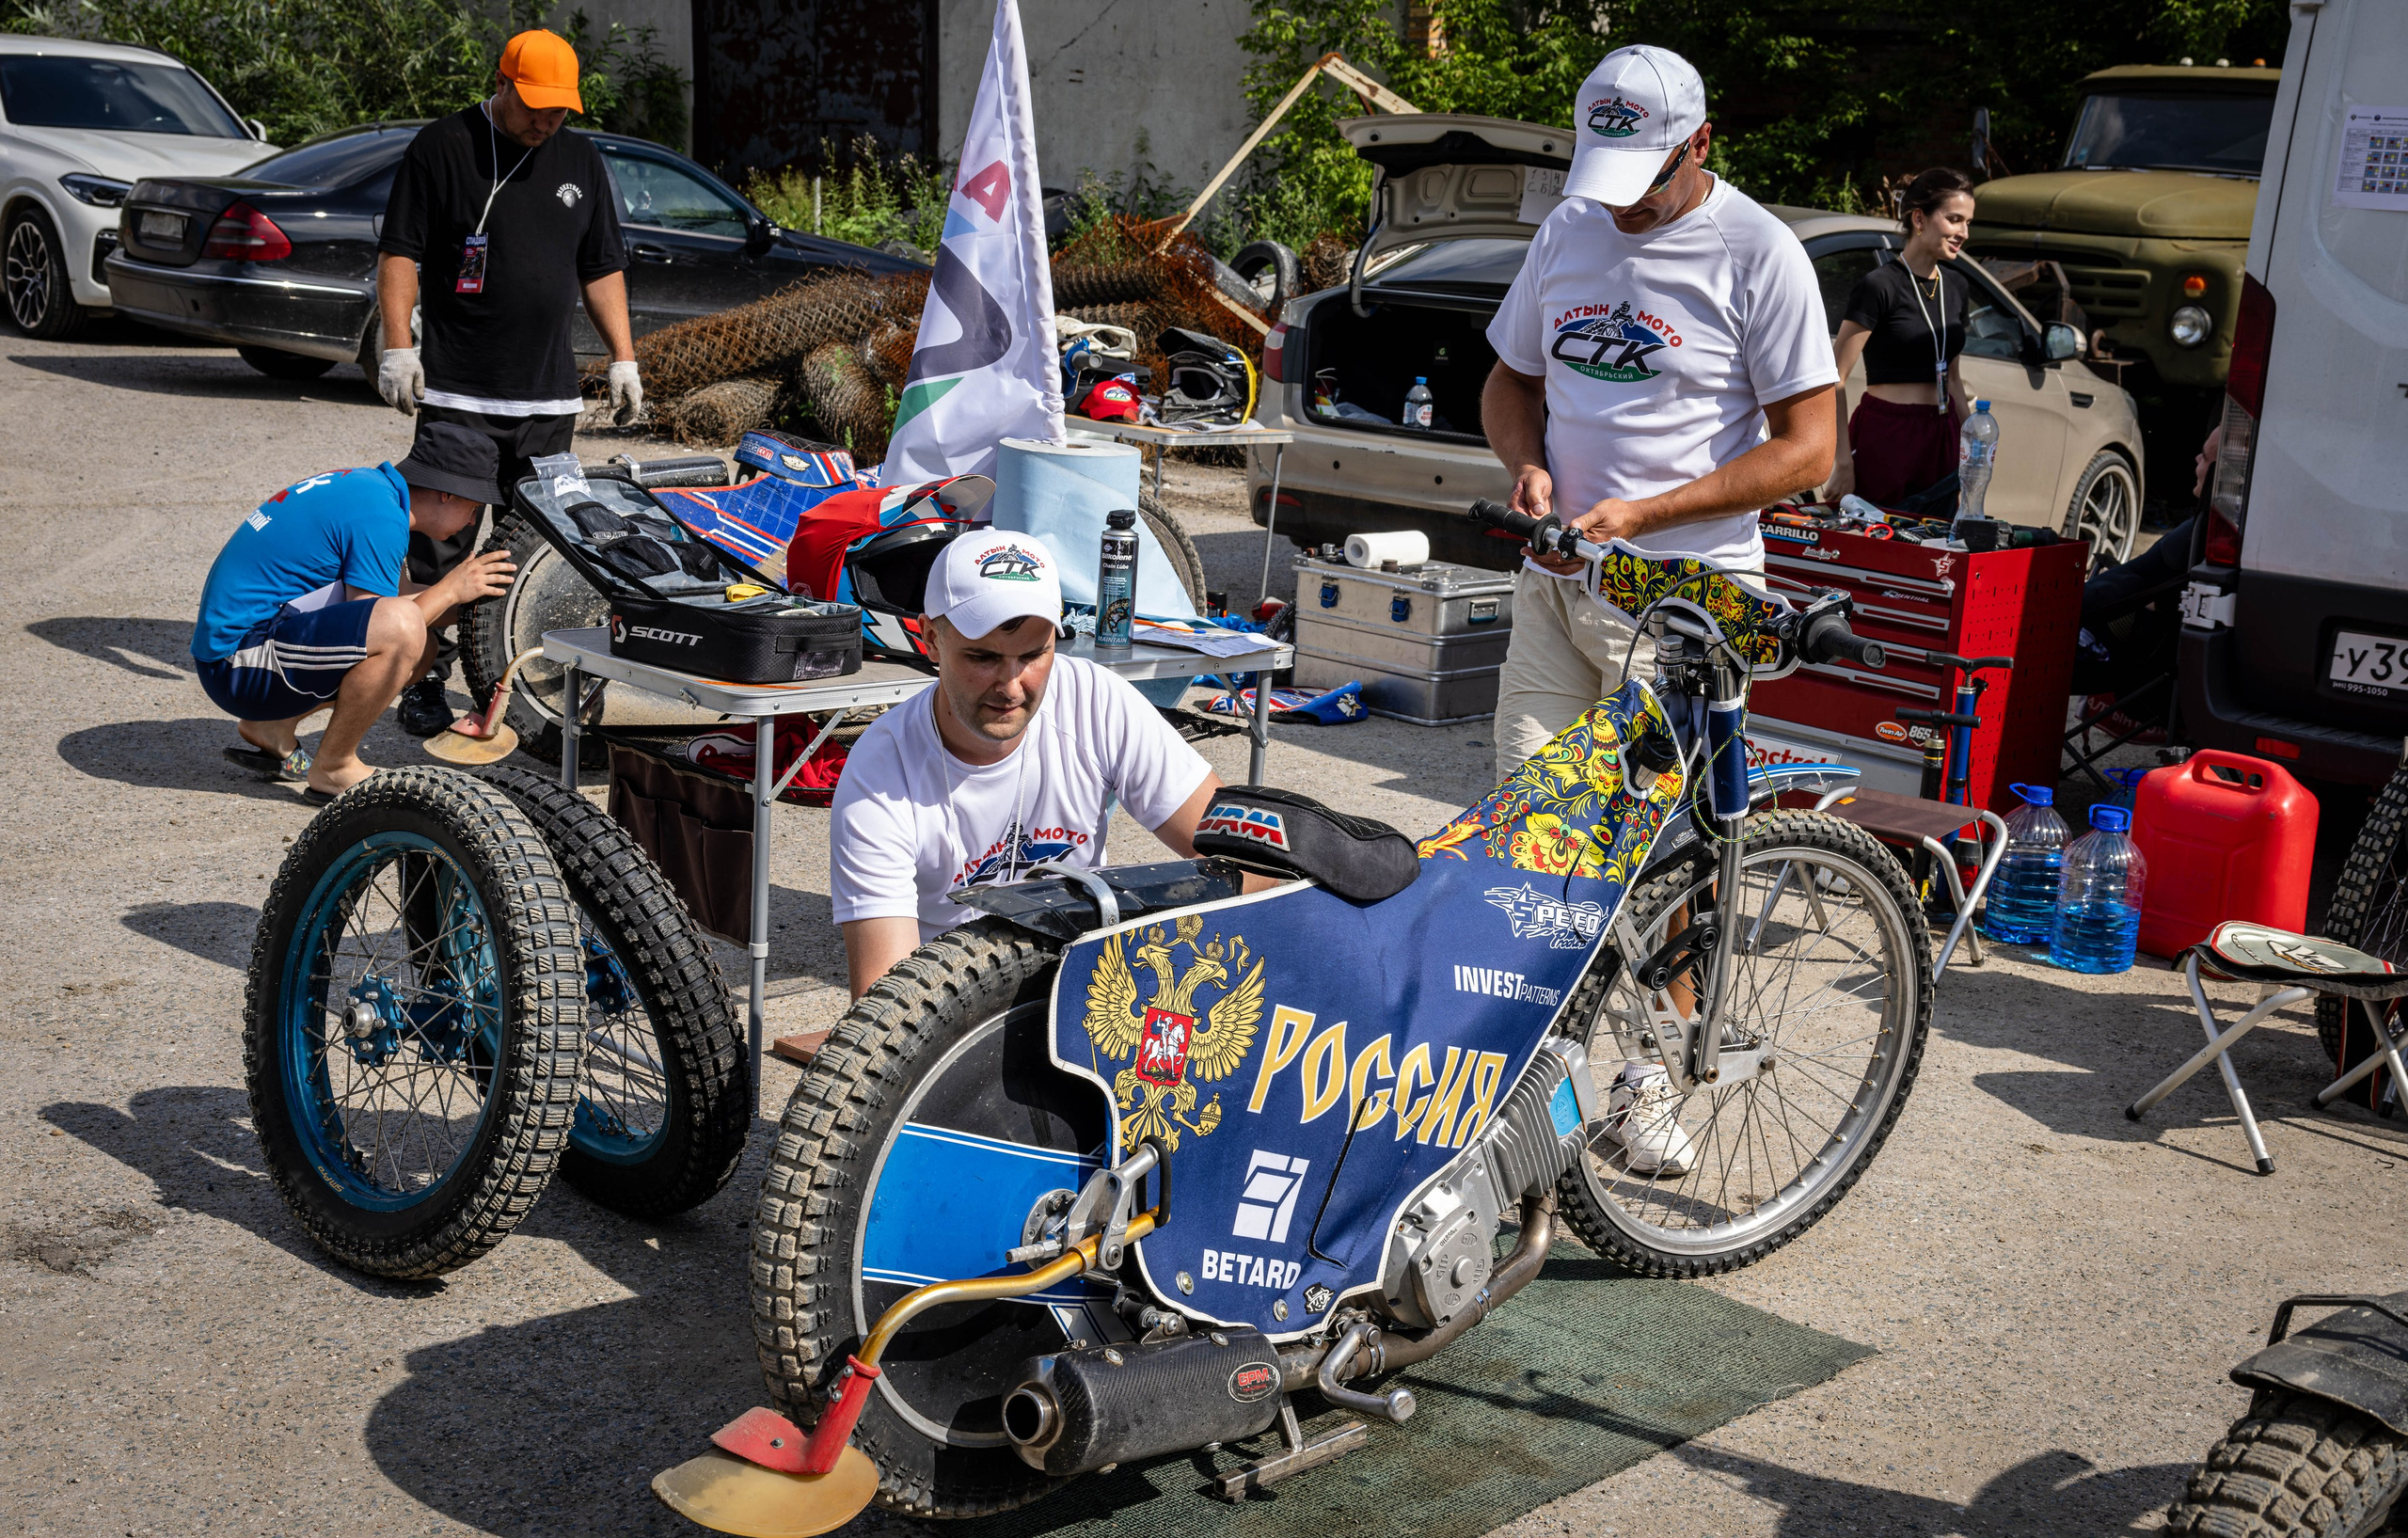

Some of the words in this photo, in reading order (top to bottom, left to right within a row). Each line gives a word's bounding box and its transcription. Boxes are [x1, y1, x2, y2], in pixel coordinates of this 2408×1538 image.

[1588, 98, 1611, 113] АЛТЫН
[1625, 100, 1649, 119] МОТО
[1588, 113, 1642, 133] СТК
[1554, 304, 1609, 331] АЛТЫН
[1636, 309, 1683, 347] МОТО
[1551, 331, 1668, 375] СТК
[1580, 364, 1634, 379] ОКТЯБРЬСКИЙ
[1757, 522, 1819, 542] CARRILLO
[974, 545, 1006, 565] АЛТЫН
[1022, 548, 1045, 569] МОТО
[980, 560, 1039, 579] СТК
[629, 626, 704, 646] SCOTT
[2347, 683, 2388, 696] 995-1050
[1879, 726, 1894, 736] Twin
[1034, 827, 1088, 846] МОТО
[1246, 1003, 1509, 1150] РОССИЯ
[1201, 1248, 1302, 1290] BETARD
[1237, 1367, 1270, 1387] GPM
